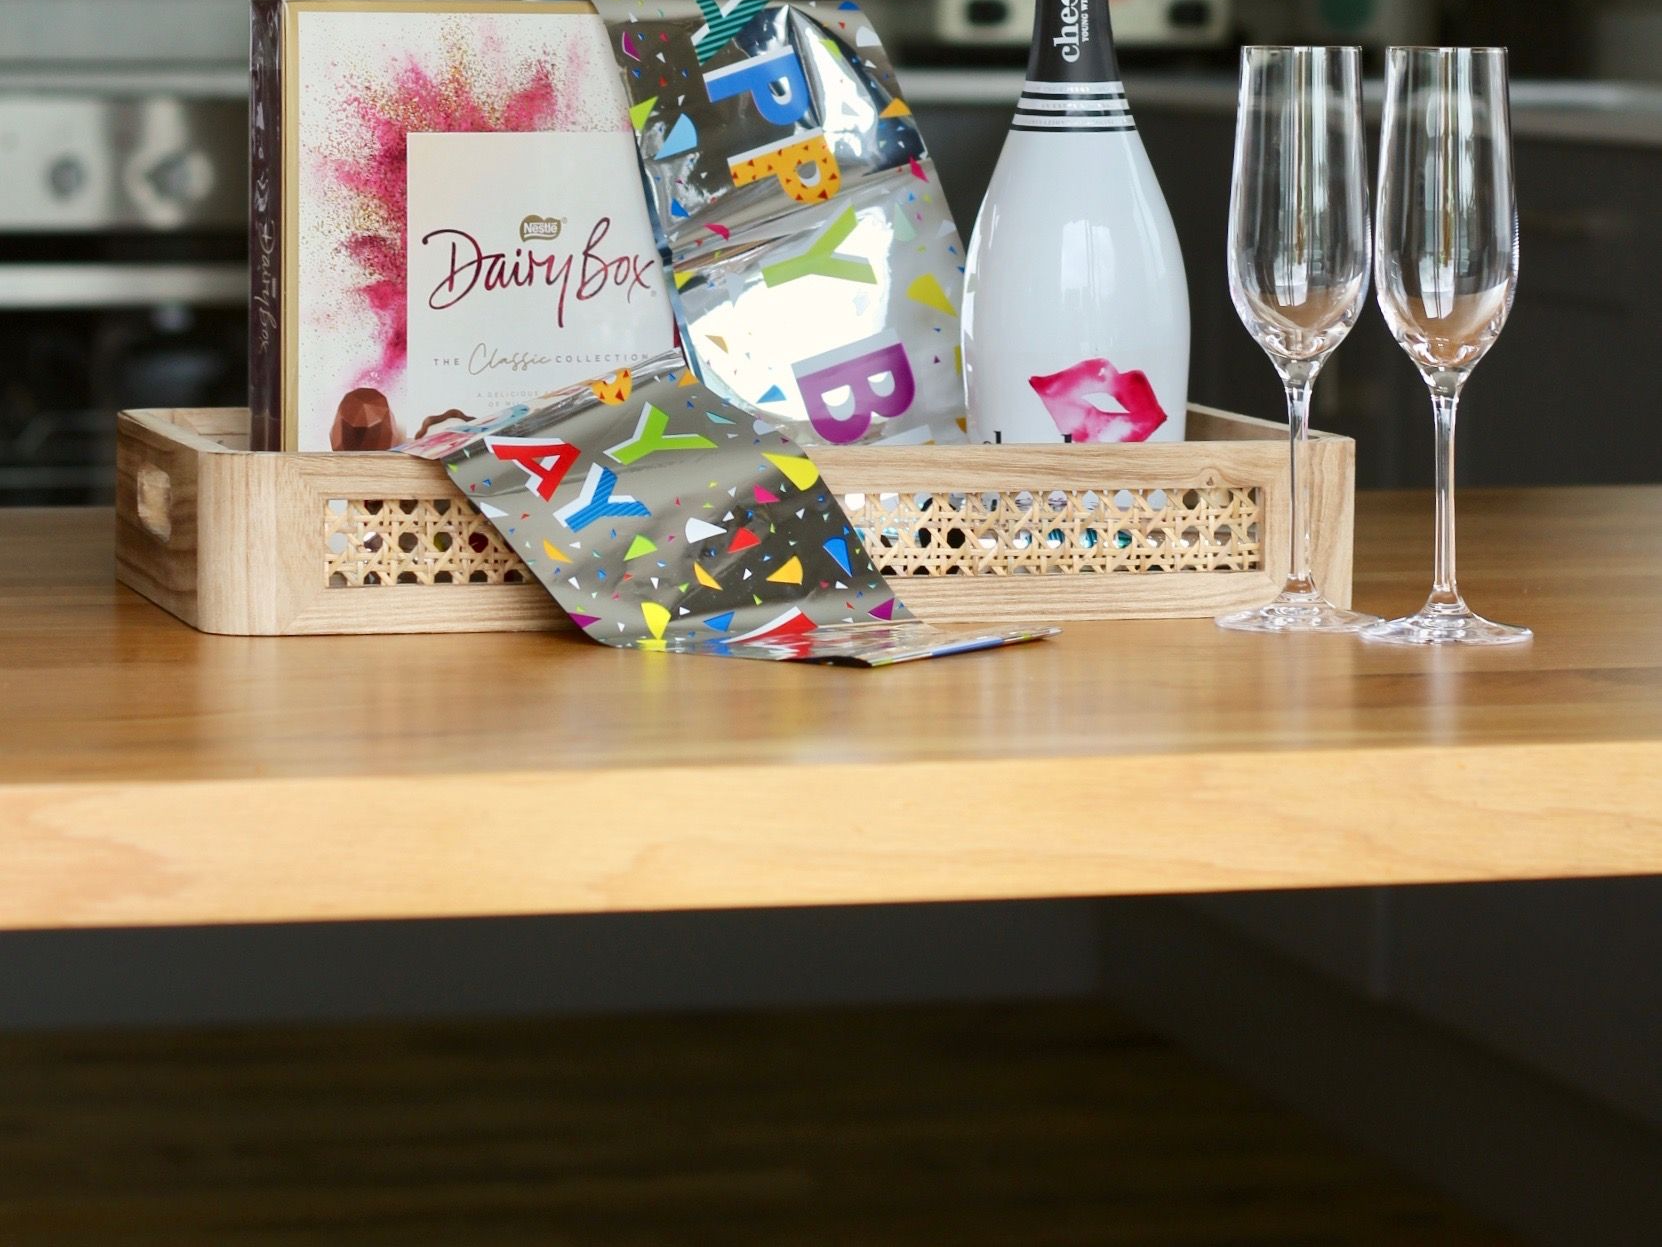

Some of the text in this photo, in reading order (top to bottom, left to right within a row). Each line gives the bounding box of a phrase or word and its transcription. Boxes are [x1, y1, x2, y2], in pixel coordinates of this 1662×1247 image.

[1081, 13, 1090, 43] YOUNG
[422, 217, 655, 328] Dairy Box
[433, 342, 649, 376] THE Classic COLLECTION
[487, 390, 539, 399] DELICIOUS
